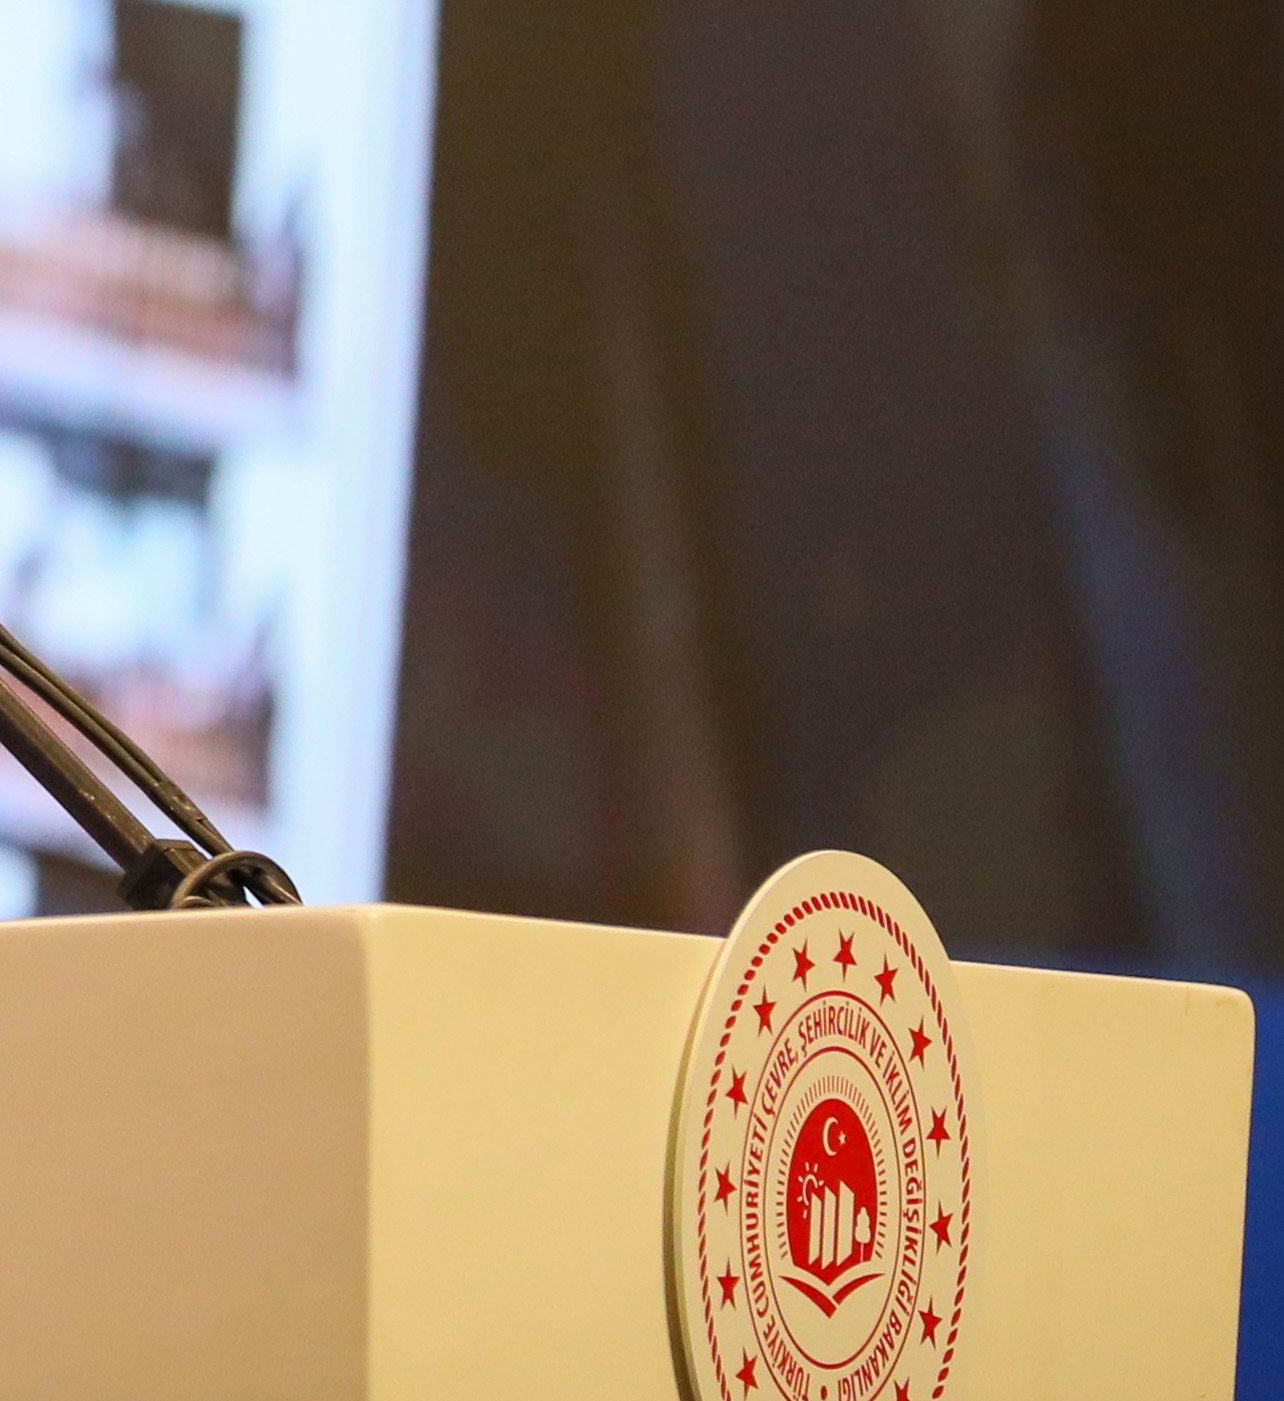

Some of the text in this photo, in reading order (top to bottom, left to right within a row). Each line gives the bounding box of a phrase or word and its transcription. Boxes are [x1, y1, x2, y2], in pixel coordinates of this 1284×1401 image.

[798, 1000, 870, 1057] ŞEHİRCİLİK
[871, 1027, 888, 1068] VE
[761, 1038, 799, 1116] ÇEVRE,
[882, 1051, 914, 1135] İKLİM
[743, 1112, 770, 1318] CUMHURİYETİ
[895, 1137, 923, 1316] DEĞİŞİKLİĞİ
[763, 1313, 810, 1401] TÜRKİYE
